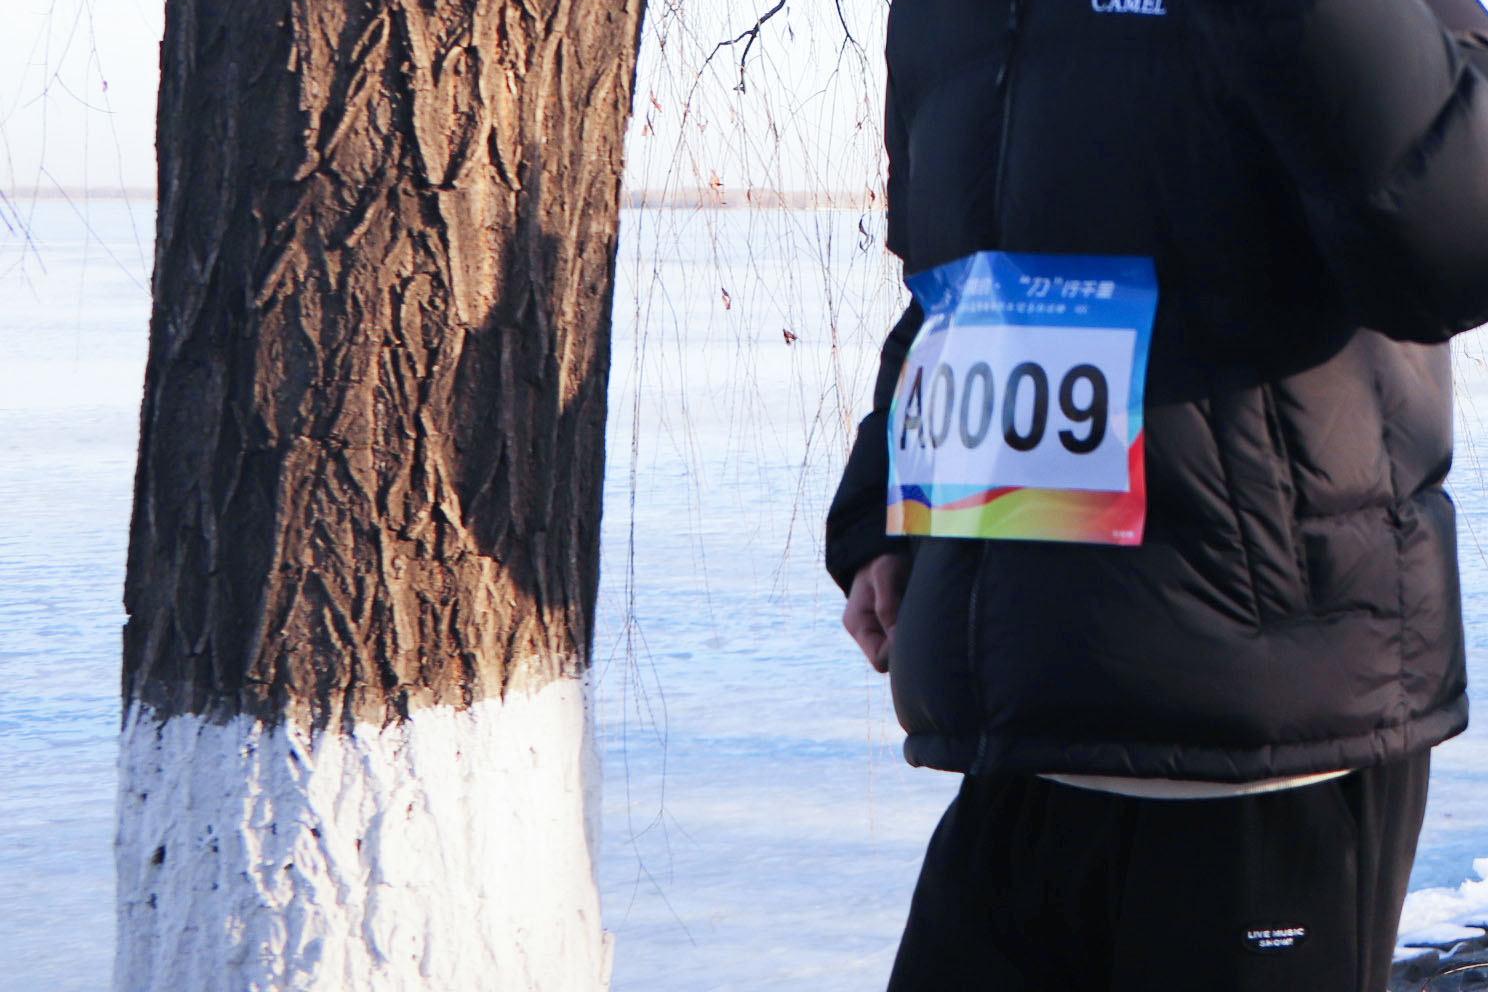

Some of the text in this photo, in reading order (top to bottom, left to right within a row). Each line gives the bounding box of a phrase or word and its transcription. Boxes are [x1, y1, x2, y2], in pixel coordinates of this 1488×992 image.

[900, 361, 1109, 455] A0009
[1247, 927, 1304, 939] LIVE MUSIC
